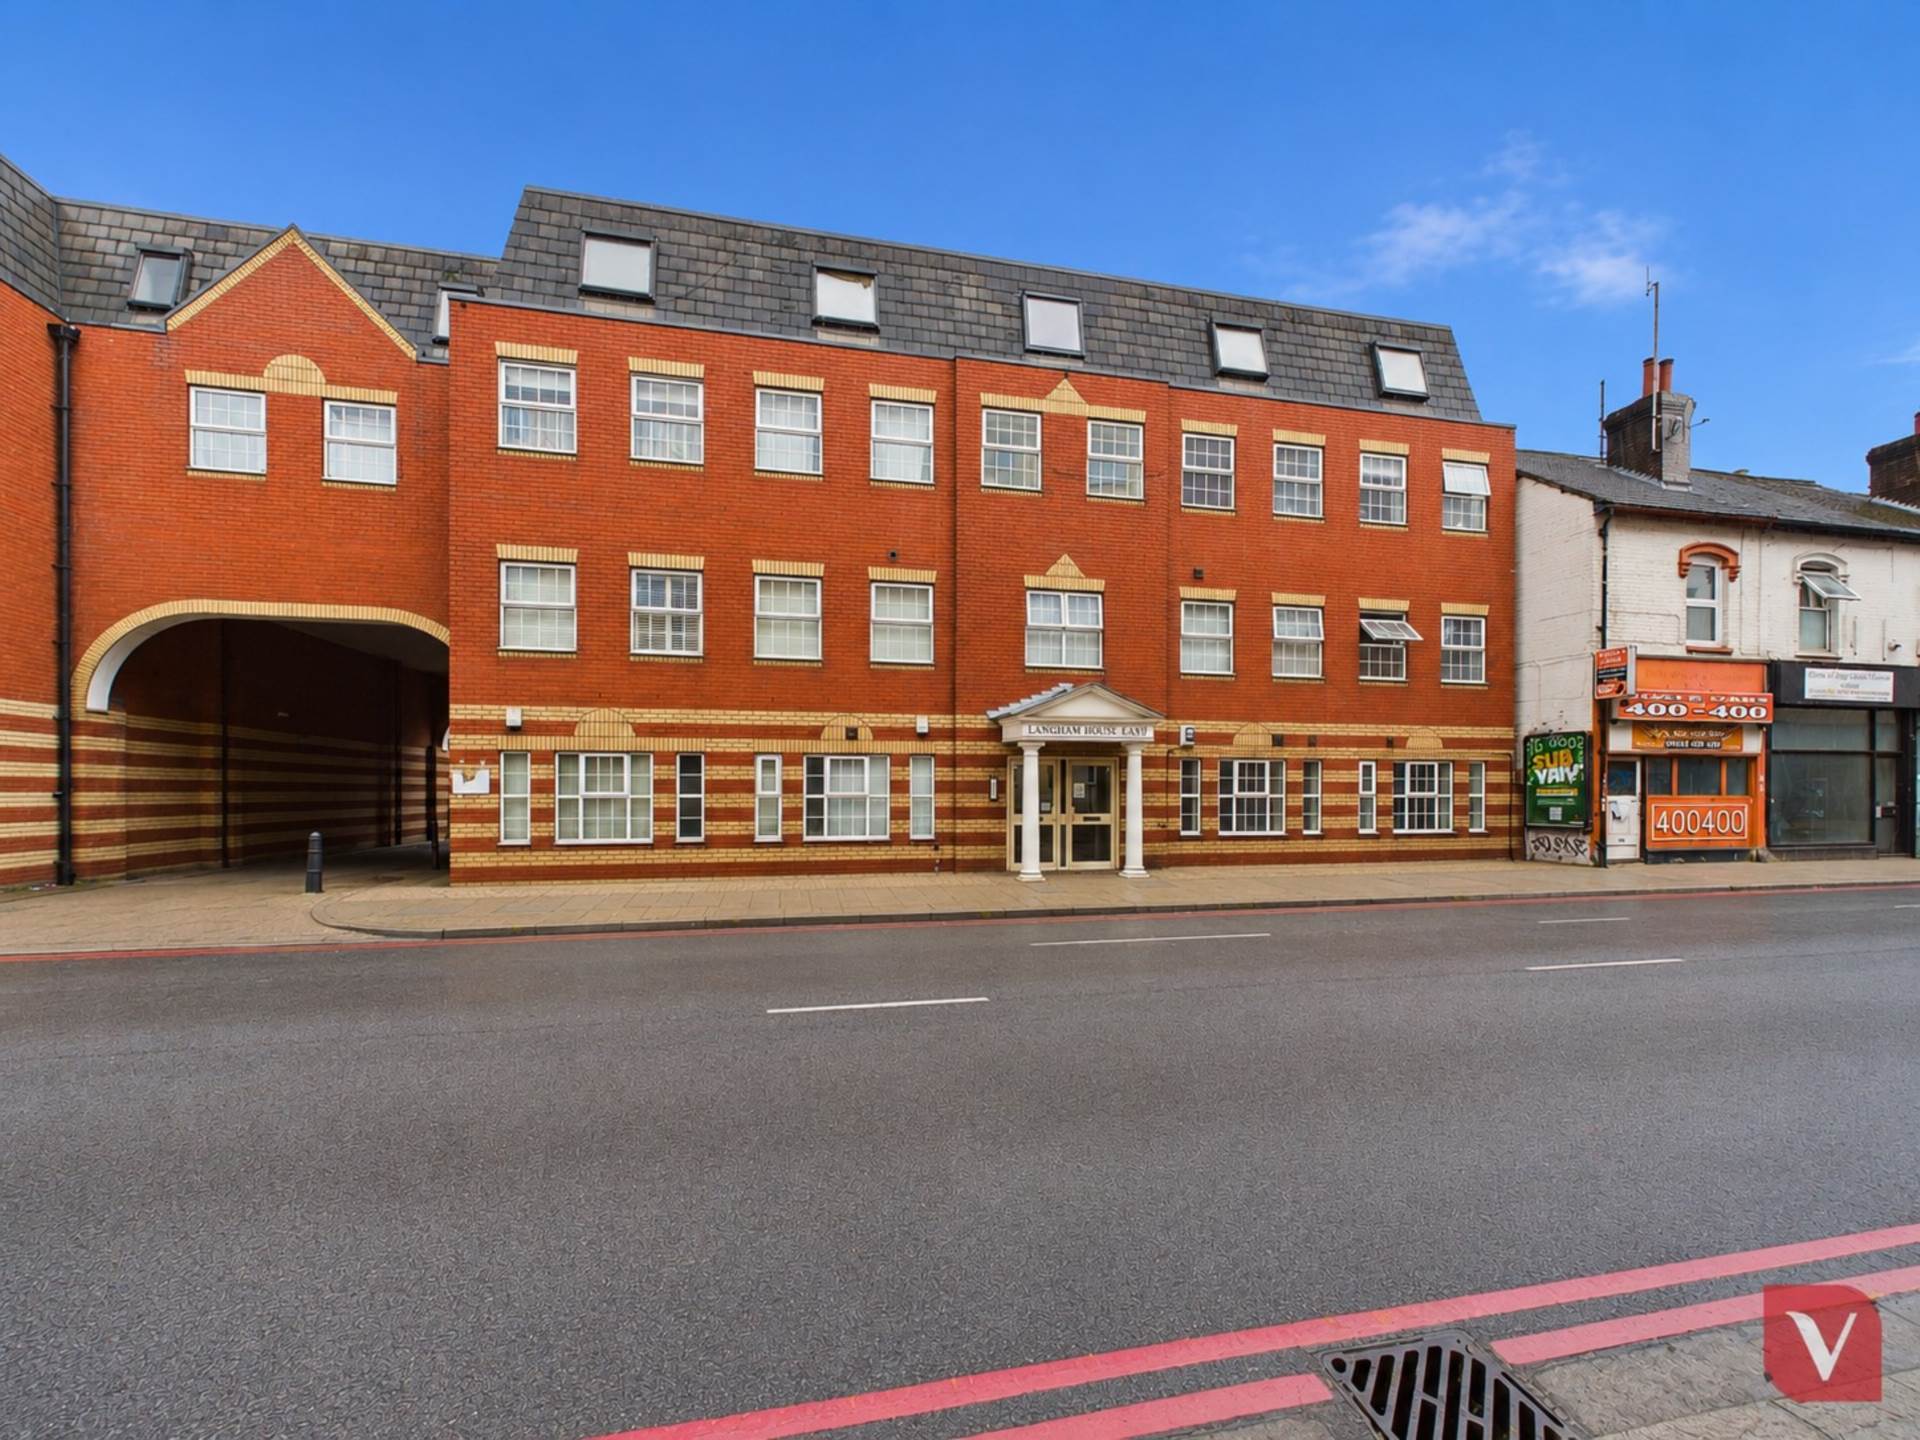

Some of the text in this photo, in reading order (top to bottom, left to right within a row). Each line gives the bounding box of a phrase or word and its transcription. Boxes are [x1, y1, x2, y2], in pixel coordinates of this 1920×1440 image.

[1028, 725, 1081, 735] LANGHAM
[1084, 725, 1116, 736] HOUSE
[1533, 748, 1573, 769] SUB
[1656, 809, 1744, 834] 400400
